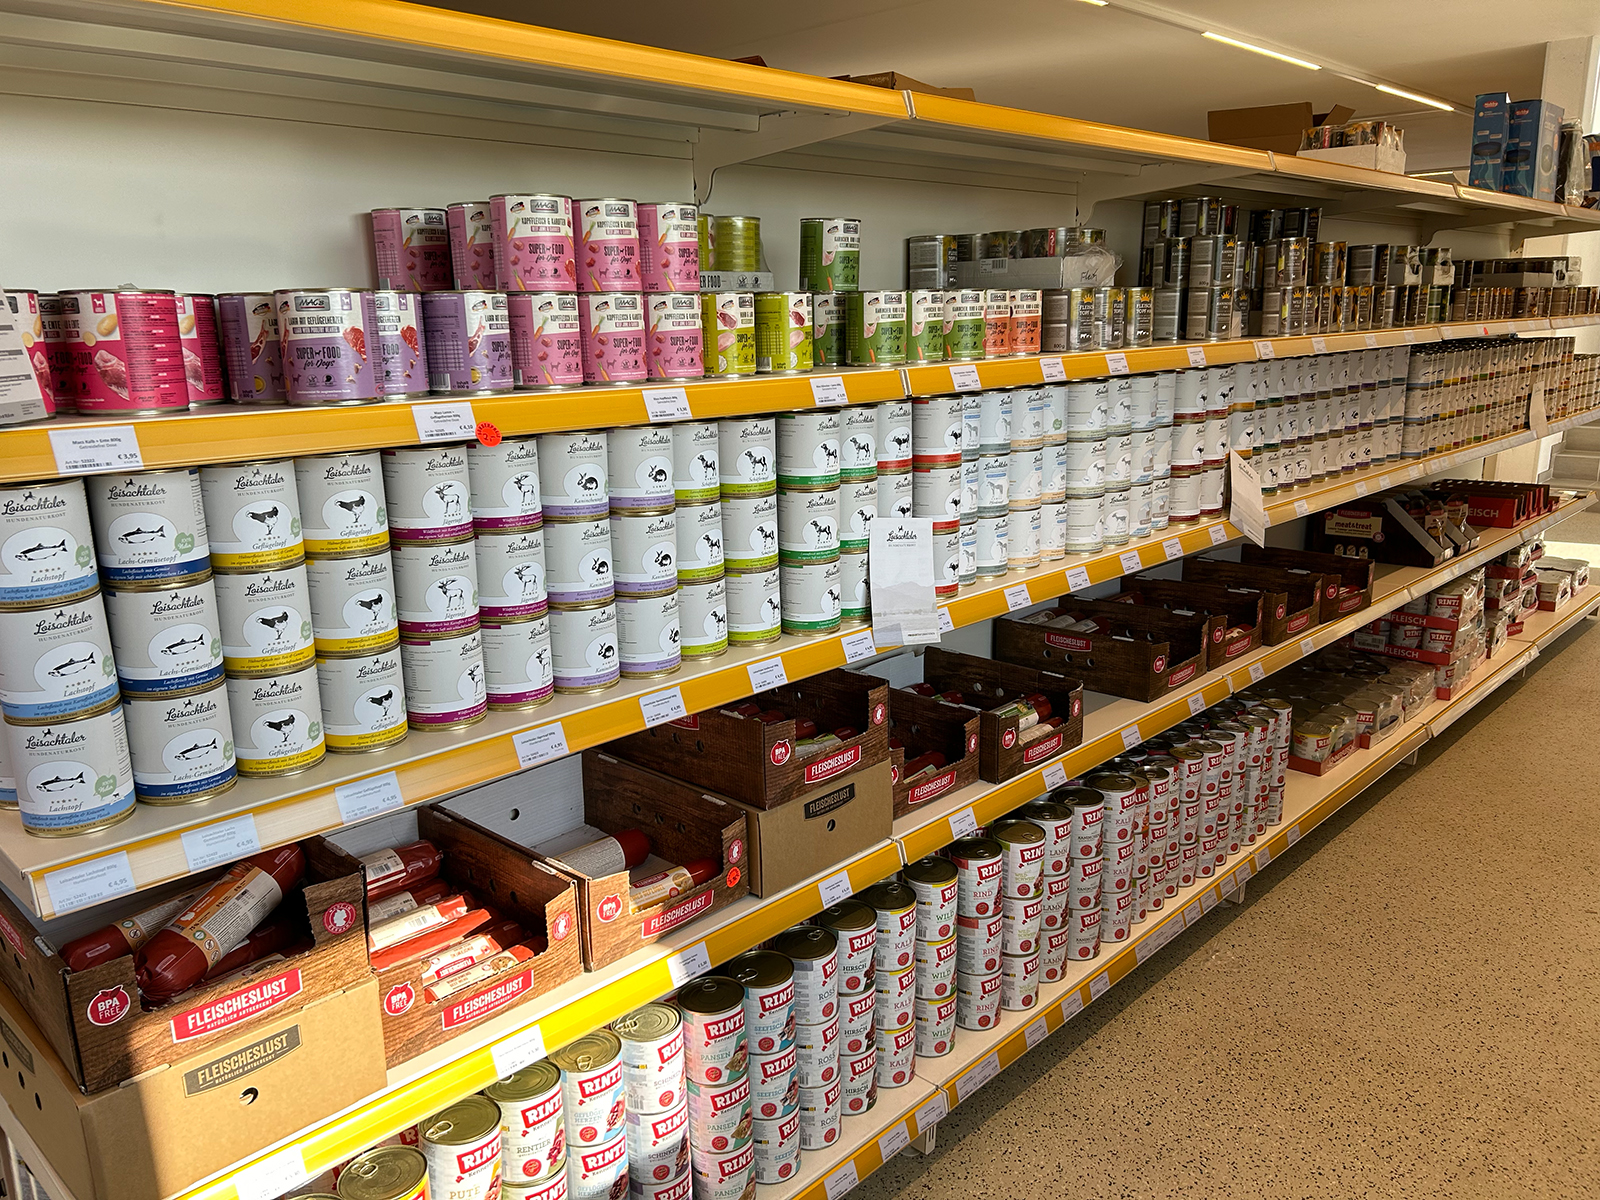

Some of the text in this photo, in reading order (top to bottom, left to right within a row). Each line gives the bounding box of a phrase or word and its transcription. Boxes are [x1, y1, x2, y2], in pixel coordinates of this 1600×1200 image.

[522, 217, 546, 225] KOPFFLEISCH
[528, 243, 564, 254] SUPER FOOD
[604, 246, 634, 256] SUPER FOOD
[535, 255, 545, 264] for
[708, 276, 721, 288] FOOD
[613, 338, 628, 348] SUPER
[670, 336, 684, 346] SUPER
[296, 346, 341, 360] SUPER FOOD
[304, 358, 335, 370] for Dogs
[324, 465, 372, 480] Loisachtaler
[234, 473, 285, 490] Loisachtaler
[107, 485, 167, 500] Loisachtaler
[1, 495, 67, 516] Loisachtaler
[1468, 508, 1499, 518] EISCH
[1334, 522, 1372, 530] meat&treat
[252, 539, 288, 552] Geflügeltopf
[118, 554, 178, 566] Lachs-Gemüsetopf
[30, 571, 67, 584] Lachstopf
[244, 581, 296, 597] Loisachtaler
[150, 596, 205, 615] Loisachtaler
[1438, 598, 1460, 606] RINTI
[34, 612, 94, 636] Loisachtaler
[64, 682, 96, 698] Lachstopf
[252, 684, 303, 701] Loisachtaler
[164, 702, 218, 722] Loisachtaler
[25, 730, 86, 750] Loisachtaler
[811, 750, 855, 777] FLEISCHESLUST
[172, 762, 226, 782] Lachs-Gemüsetopf
[914, 776, 950, 797] FLEISCHESLUST
[49, 802, 84, 813] Lachstopf
[809, 788, 850, 813] FLEISCHESLUST
[114, 878, 128, 887] 4,95
[602, 902, 616, 913] BPA
[650, 895, 706, 930] FLEISCHESLUST
[97, 997, 120, 1012] BPA
[187, 978, 288, 1030] FLEISCHESLUST
[391, 993, 407, 1004] BPA
[452, 977, 524, 1020] FLEISCHESLUST
[98, 1005, 122, 1020] FREE
[206, 998, 273, 1030] NATÜRLICH ARTGERECHT
[708, 1010, 745, 1037] RINTI
[197, 1035, 288, 1085] FLEISCHESLUST
[700, 1051, 731, 1062] PANSEN
[583, 1066, 622, 1094] RINTI
[714, 1080, 750, 1109] RINTI
[707, 1120, 737, 1132] PANSEN
[516, 1139, 551, 1154] RENTIER
[586, 1142, 626, 1168] RINTI
[450, 1186, 480, 1200] PUTE
[714, 1185, 744, 1197] PANSEN
